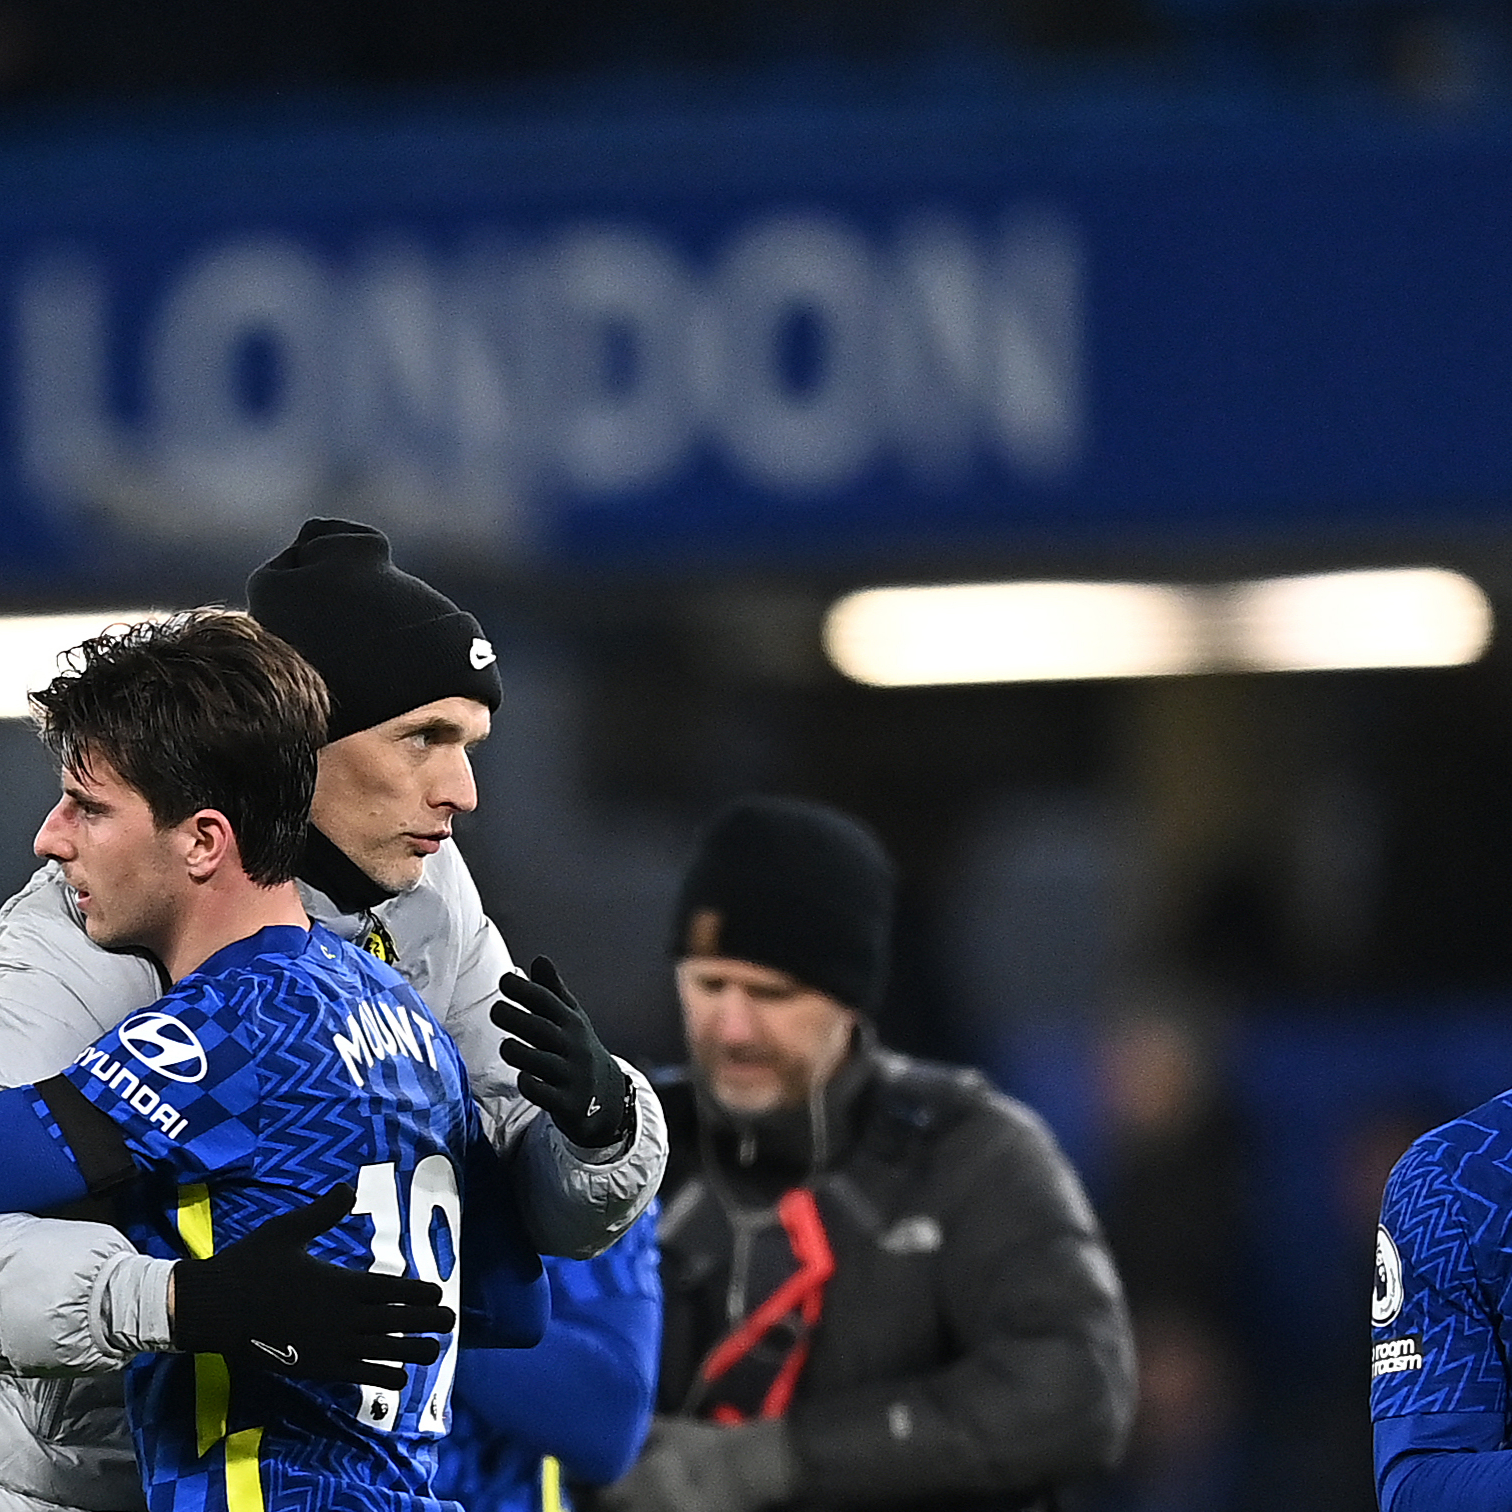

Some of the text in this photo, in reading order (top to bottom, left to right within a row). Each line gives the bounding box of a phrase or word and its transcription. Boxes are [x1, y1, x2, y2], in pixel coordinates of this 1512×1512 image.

[12, 212, 1084, 508] LONDON
[332, 999, 438, 1089] MOUNT
[350, 1154, 461, 1435] 19
